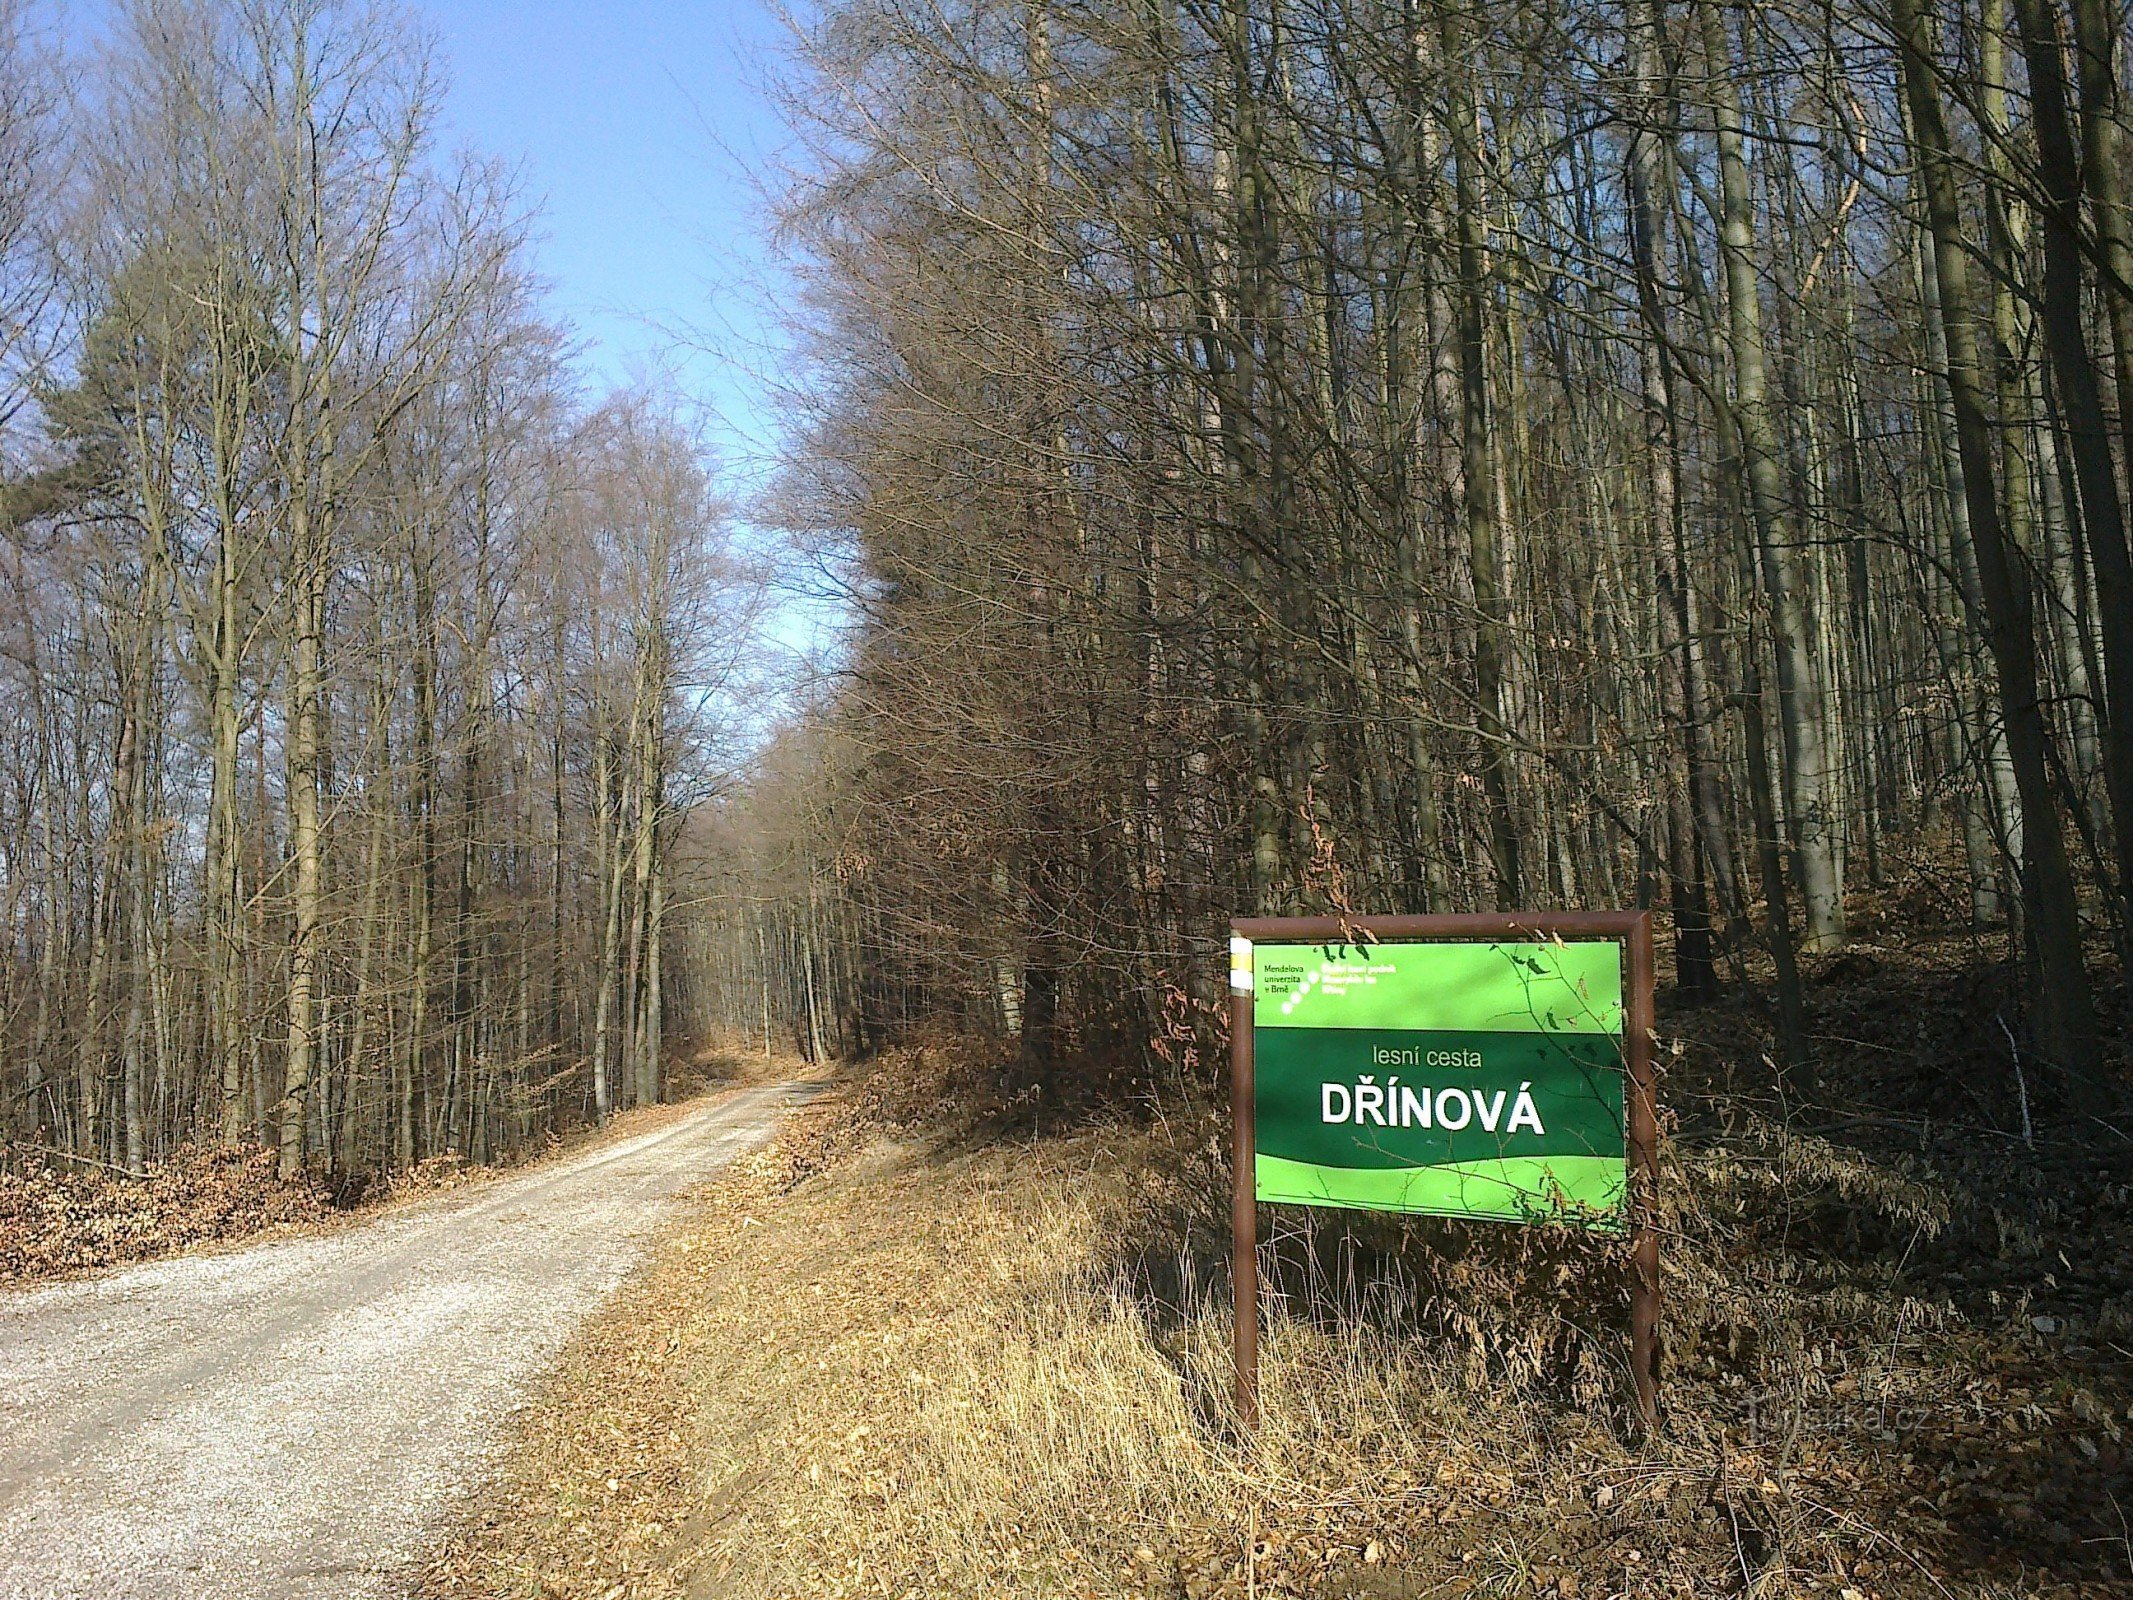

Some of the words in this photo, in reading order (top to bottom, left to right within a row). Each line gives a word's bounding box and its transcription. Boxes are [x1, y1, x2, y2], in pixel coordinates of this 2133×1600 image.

[1264, 965, 1304, 973] Mendelova
[1264, 975, 1301, 984] univerzita
[1271, 985, 1289, 993] Brně
[1373, 1044, 1420, 1066] lesní
[1426, 1048, 1482, 1068] cesta
[1321, 1074, 1546, 1136] DŘÍNOVÁ
